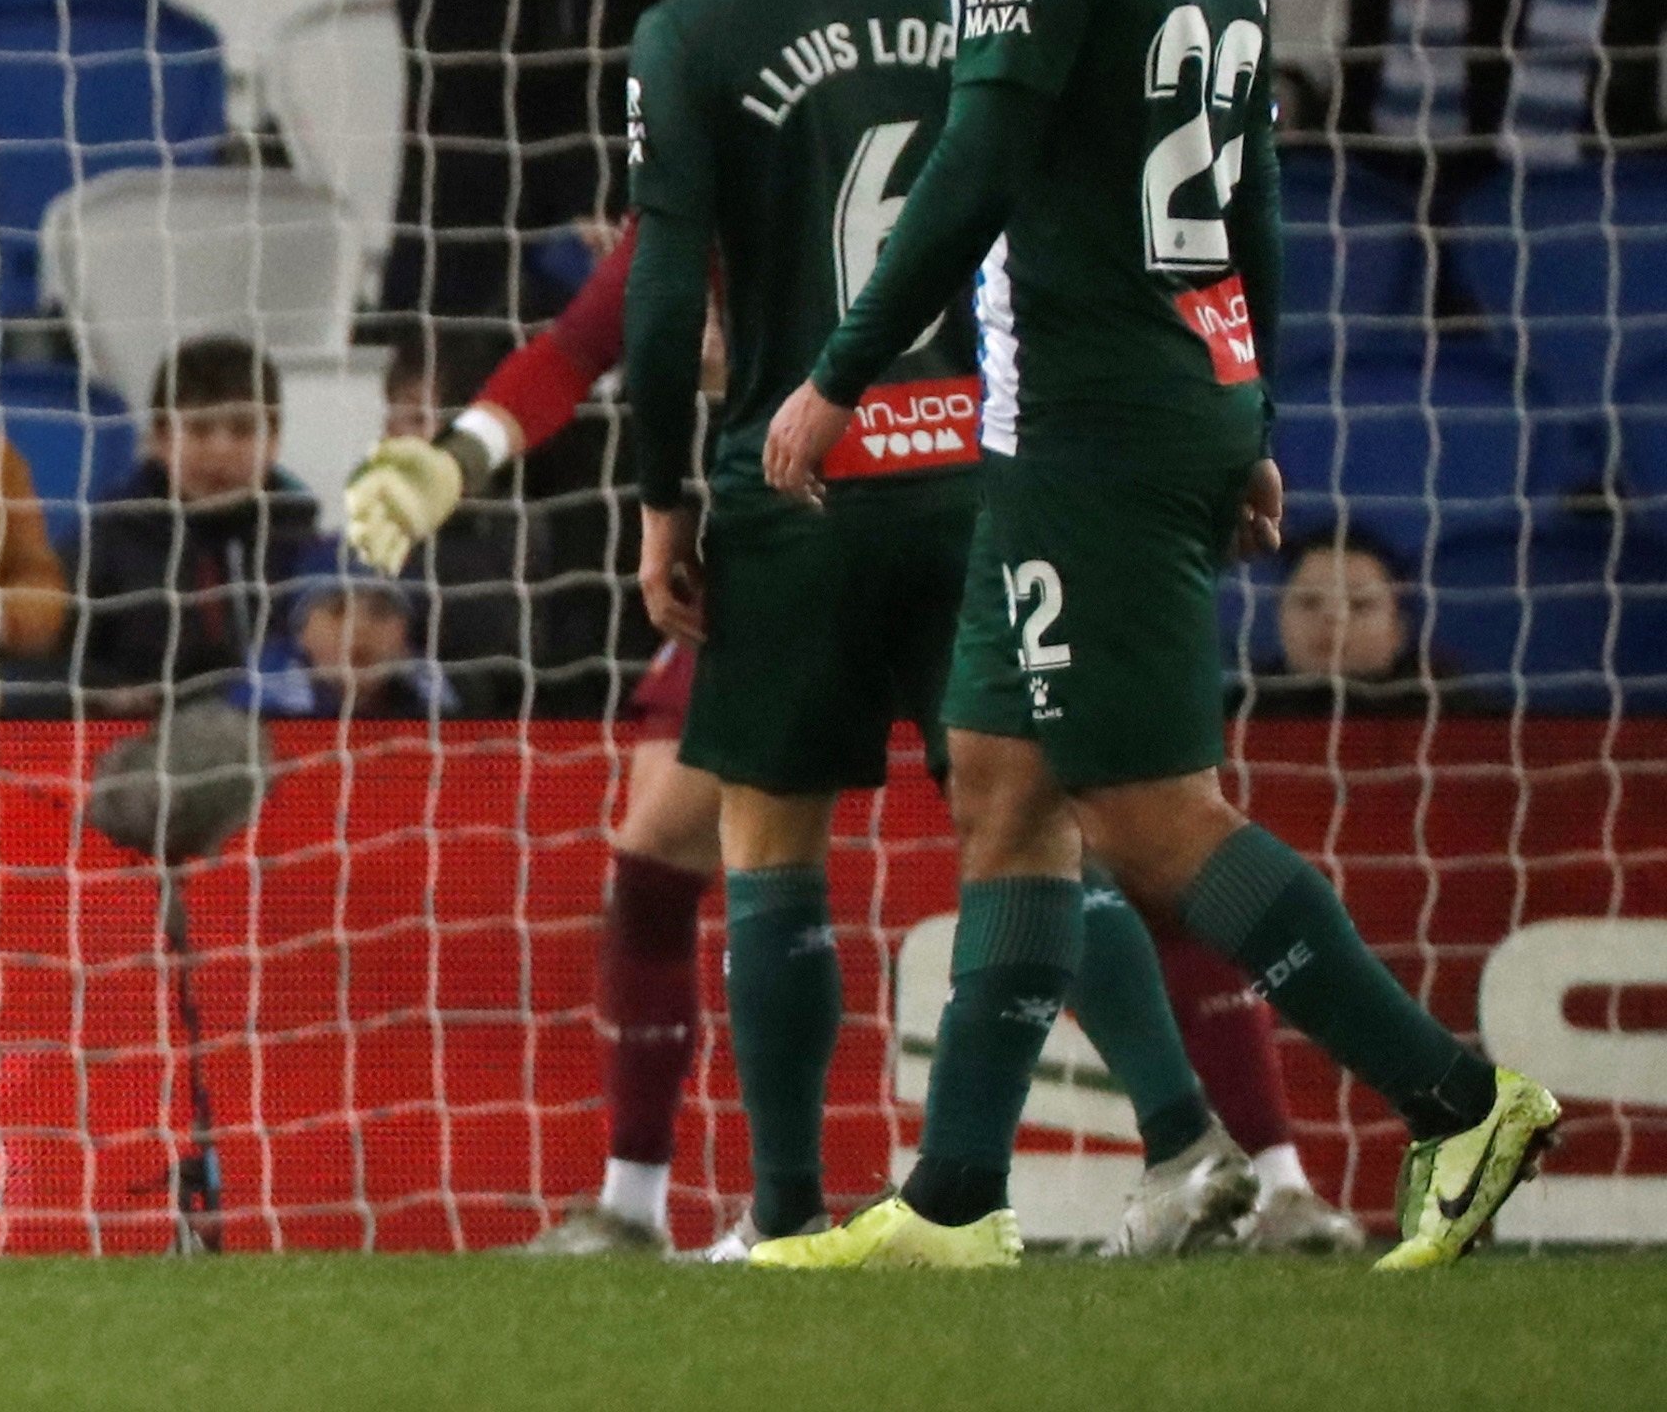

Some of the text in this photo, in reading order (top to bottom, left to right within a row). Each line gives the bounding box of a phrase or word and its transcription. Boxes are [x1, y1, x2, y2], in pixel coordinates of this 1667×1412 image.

[741, 17, 958, 127] LLUIS LOP
[963, 5, 1032, 39] MAYA
[1142, 4, 1263, 272] 22
[832, 120, 947, 356] 6
[862, 427, 966, 460] VOOM
[1002, 559, 1071, 672] 2
